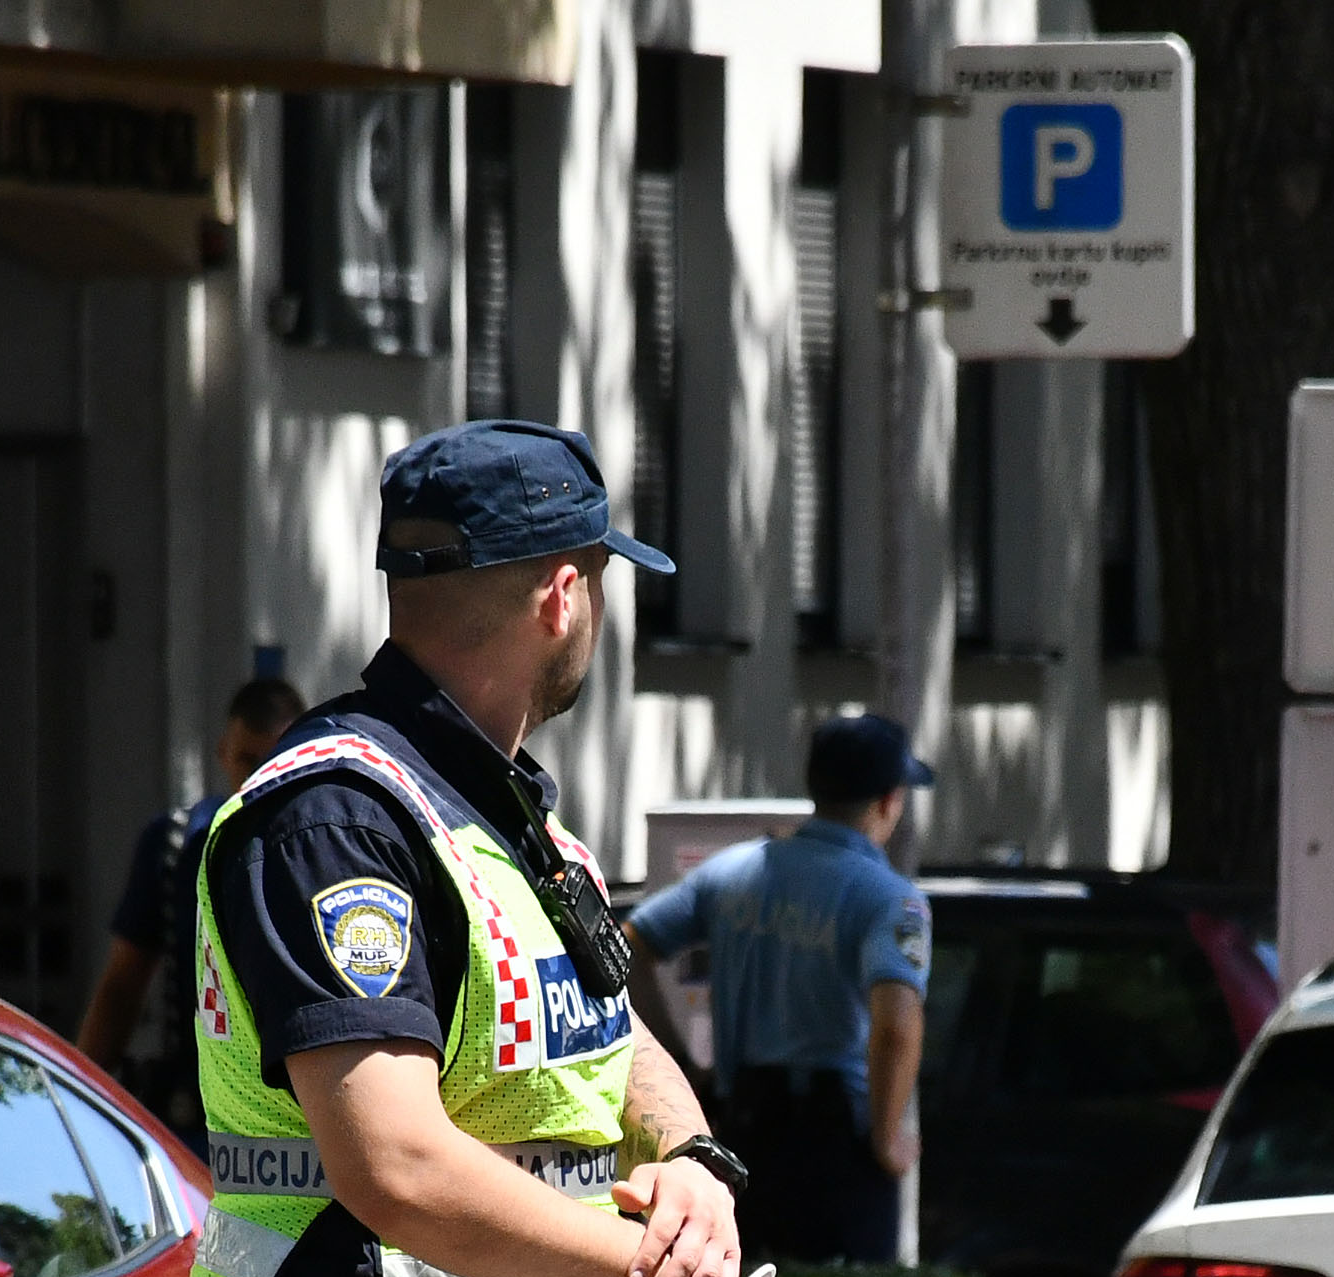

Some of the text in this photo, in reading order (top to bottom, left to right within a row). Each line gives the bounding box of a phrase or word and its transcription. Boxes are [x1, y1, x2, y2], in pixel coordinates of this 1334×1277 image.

[1034, 125, 1095, 211] P
[320, 887, 408, 918] POLICIJA
[350, 926, 387, 947] RH
[350, 950, 388, 961] MUP
